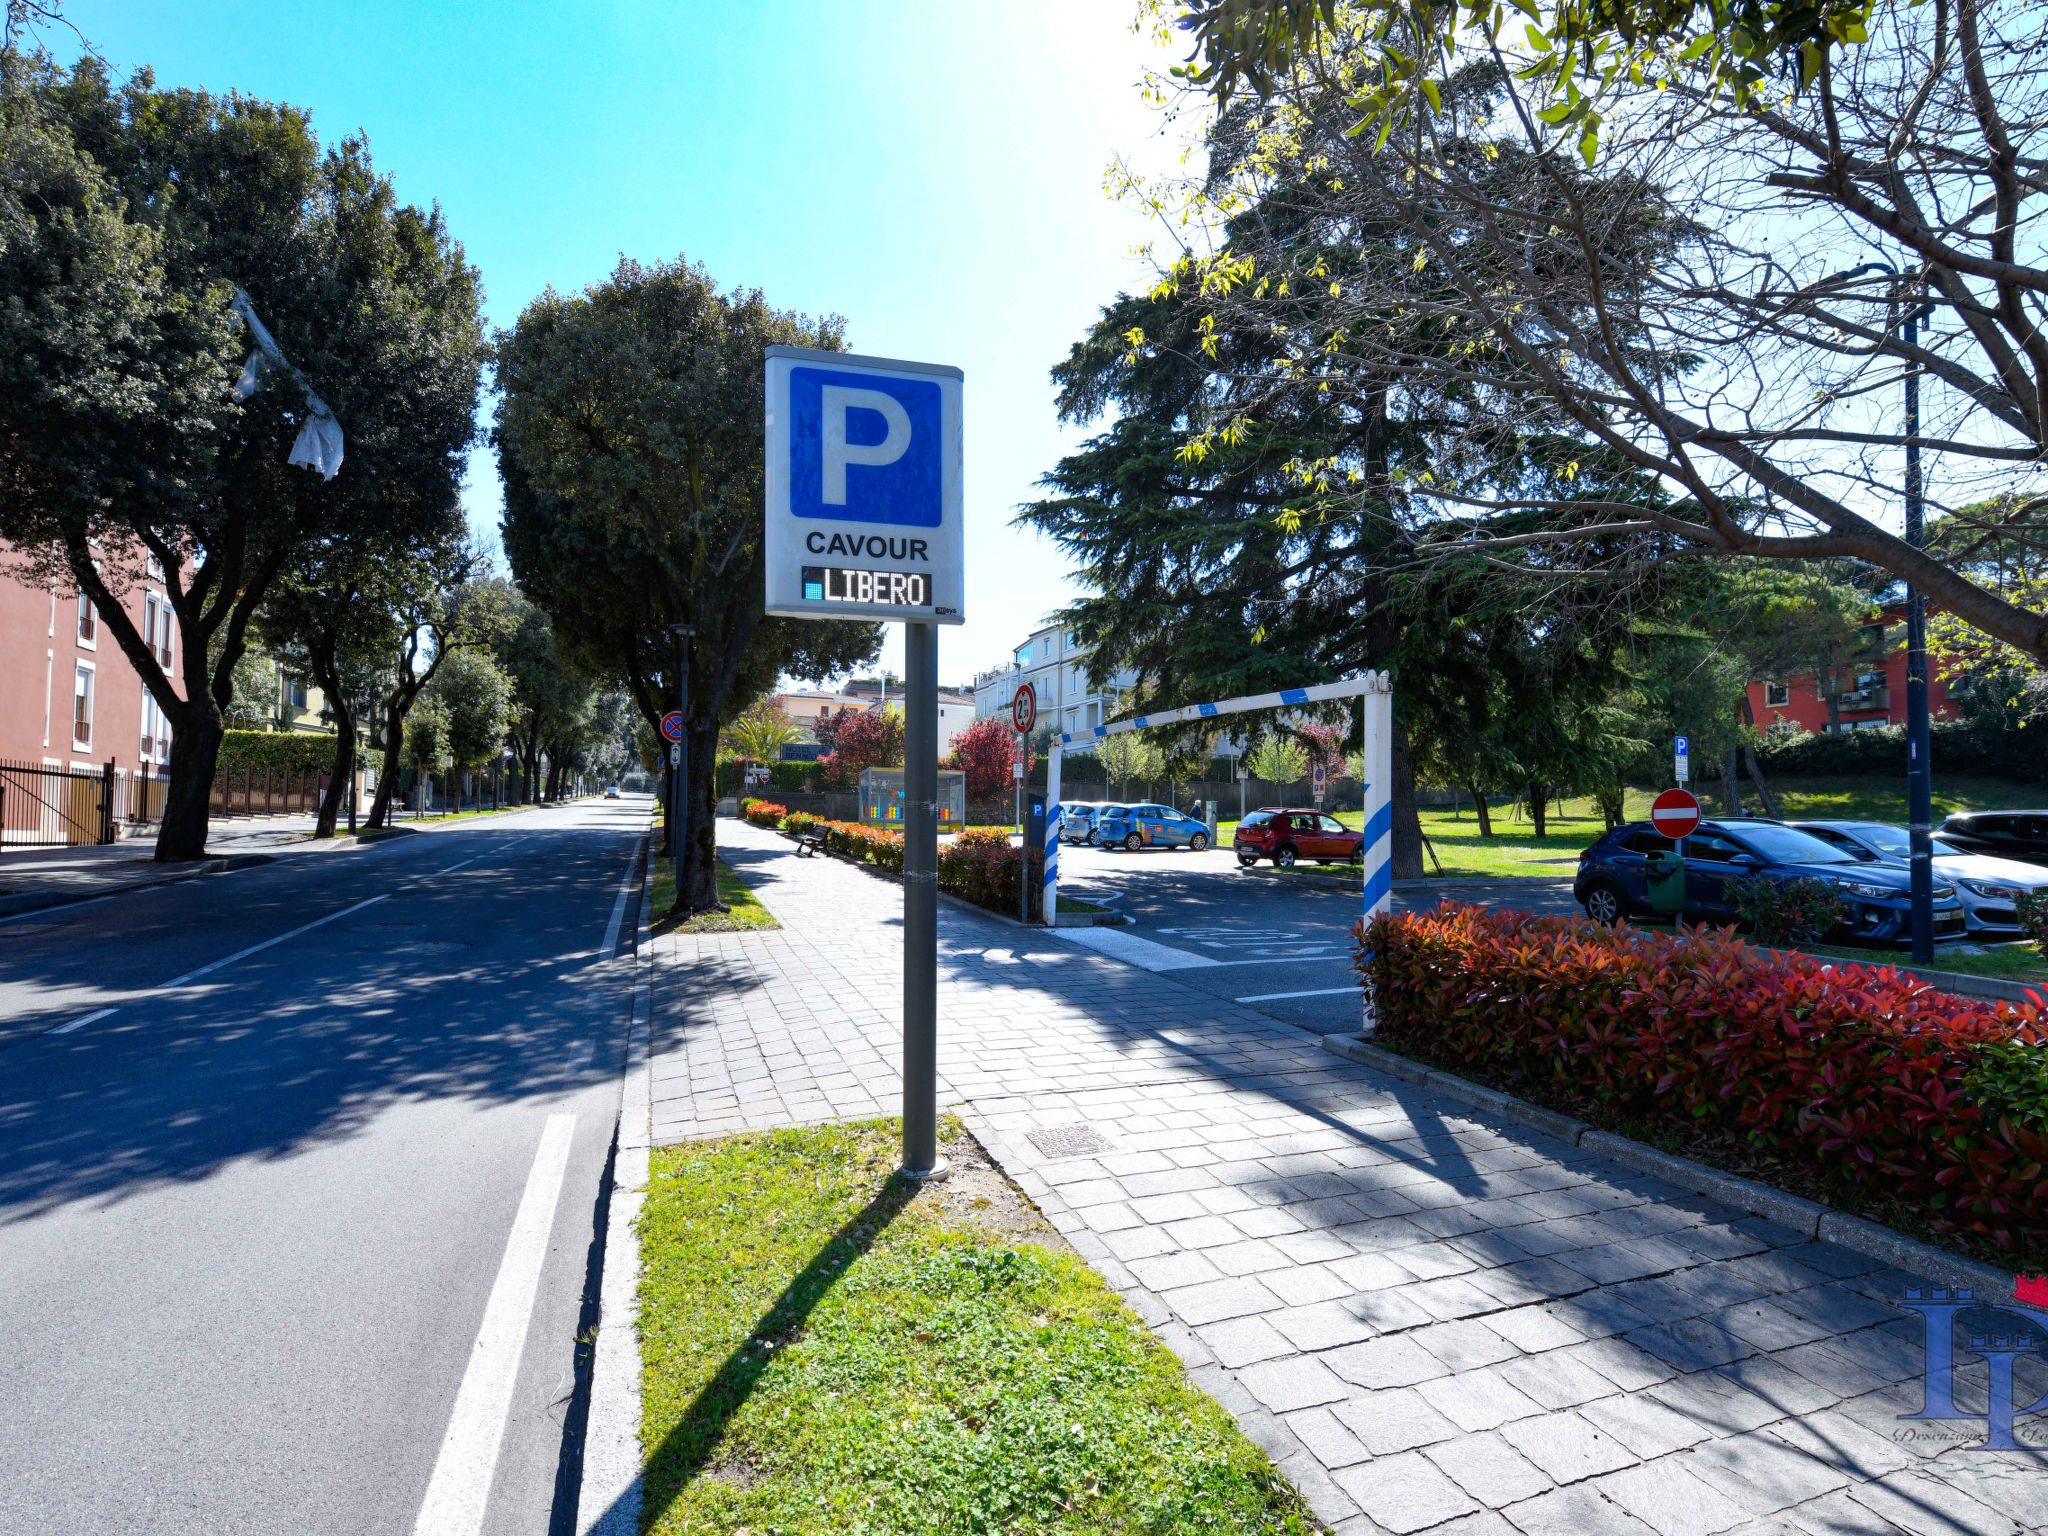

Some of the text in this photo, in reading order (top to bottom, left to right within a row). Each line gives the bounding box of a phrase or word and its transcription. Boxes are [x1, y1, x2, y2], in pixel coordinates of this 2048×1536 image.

[822, 384, 912, 505] P
[806, 532, 928, 561] CAVOUR
[824, 568, 924, 607] LIBERO
[1678, 739, 1686, 753] P
[1034, 805, 1041, 814] P
